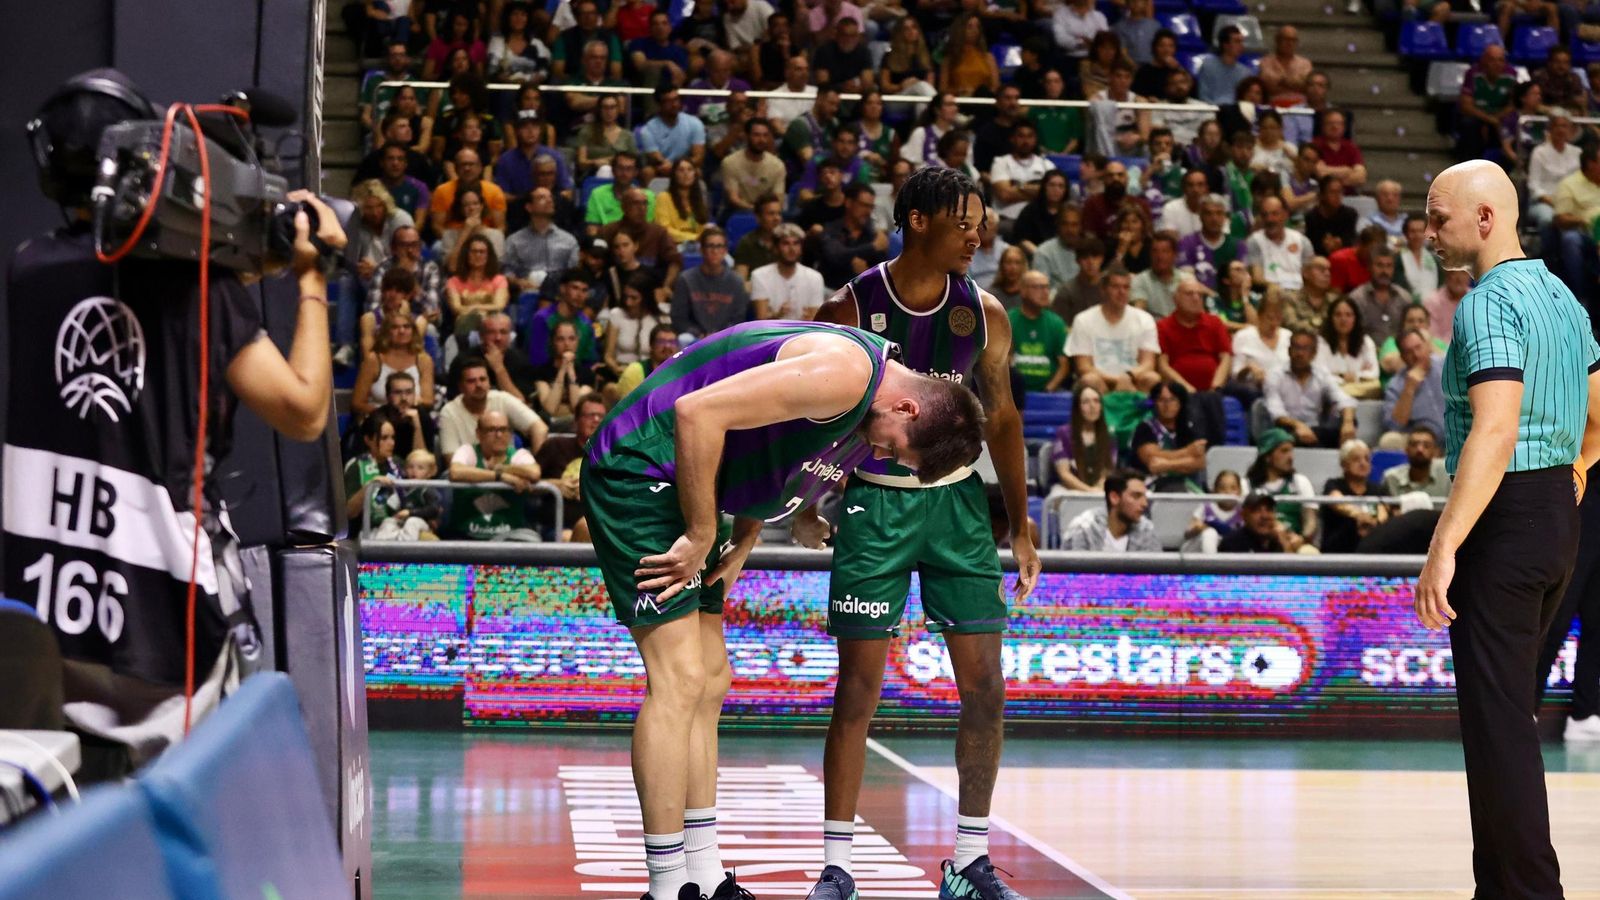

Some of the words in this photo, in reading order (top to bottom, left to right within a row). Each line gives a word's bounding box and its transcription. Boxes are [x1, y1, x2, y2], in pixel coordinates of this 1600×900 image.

[51, 467, 117, 538] HB
[24, 552, 128, 643] 166
[832, 594, 890, 618] málaga
[907, 635, 1234, 683] srestars
